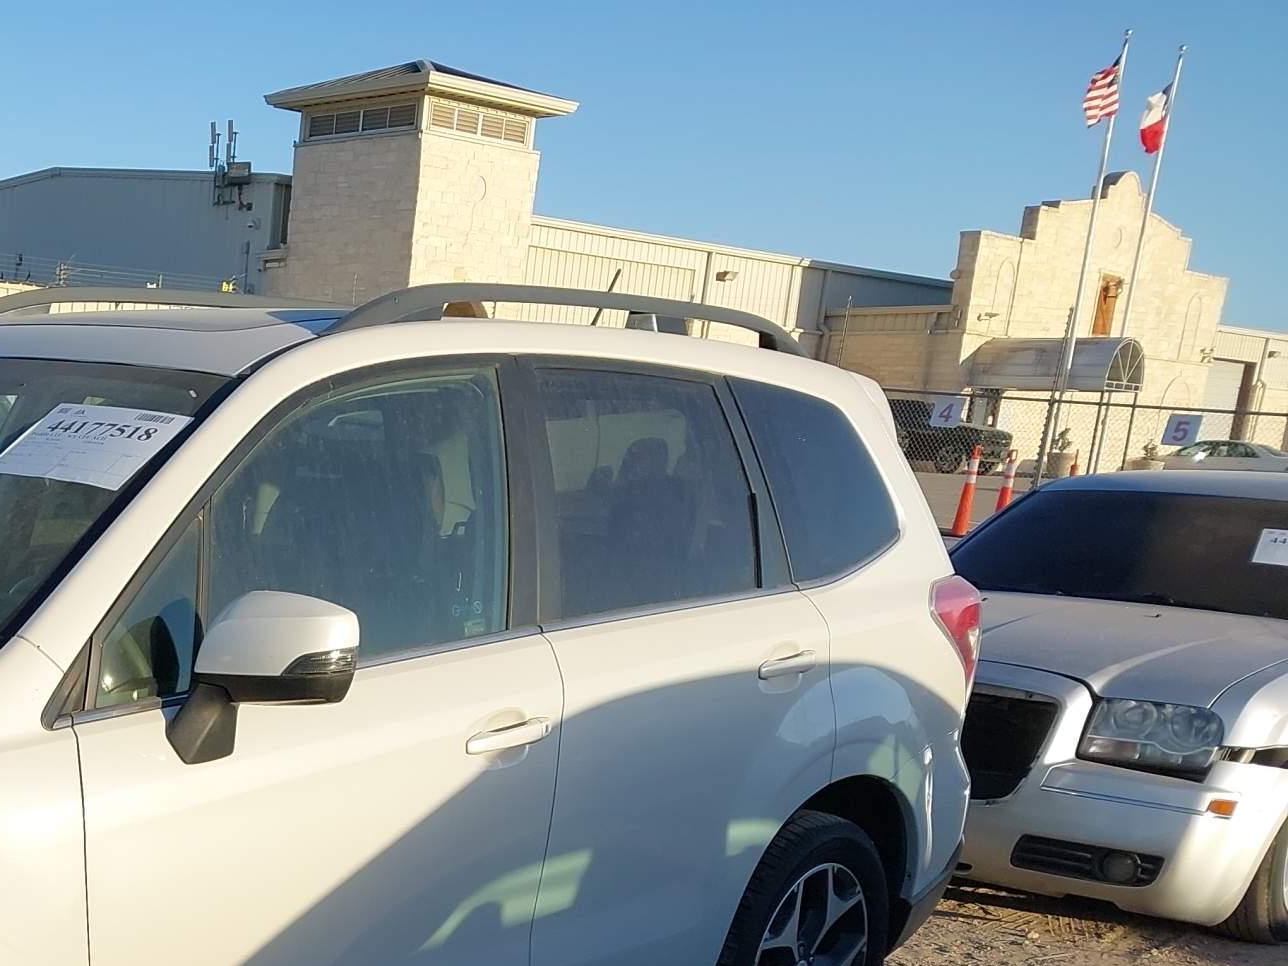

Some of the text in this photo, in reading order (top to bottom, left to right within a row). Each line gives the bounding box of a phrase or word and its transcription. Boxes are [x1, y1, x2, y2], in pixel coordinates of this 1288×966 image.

[939, 403, 954, 422] 4
[47, 419, 158, 441] 44177518
[1172, 421, 1190, 441] 5
